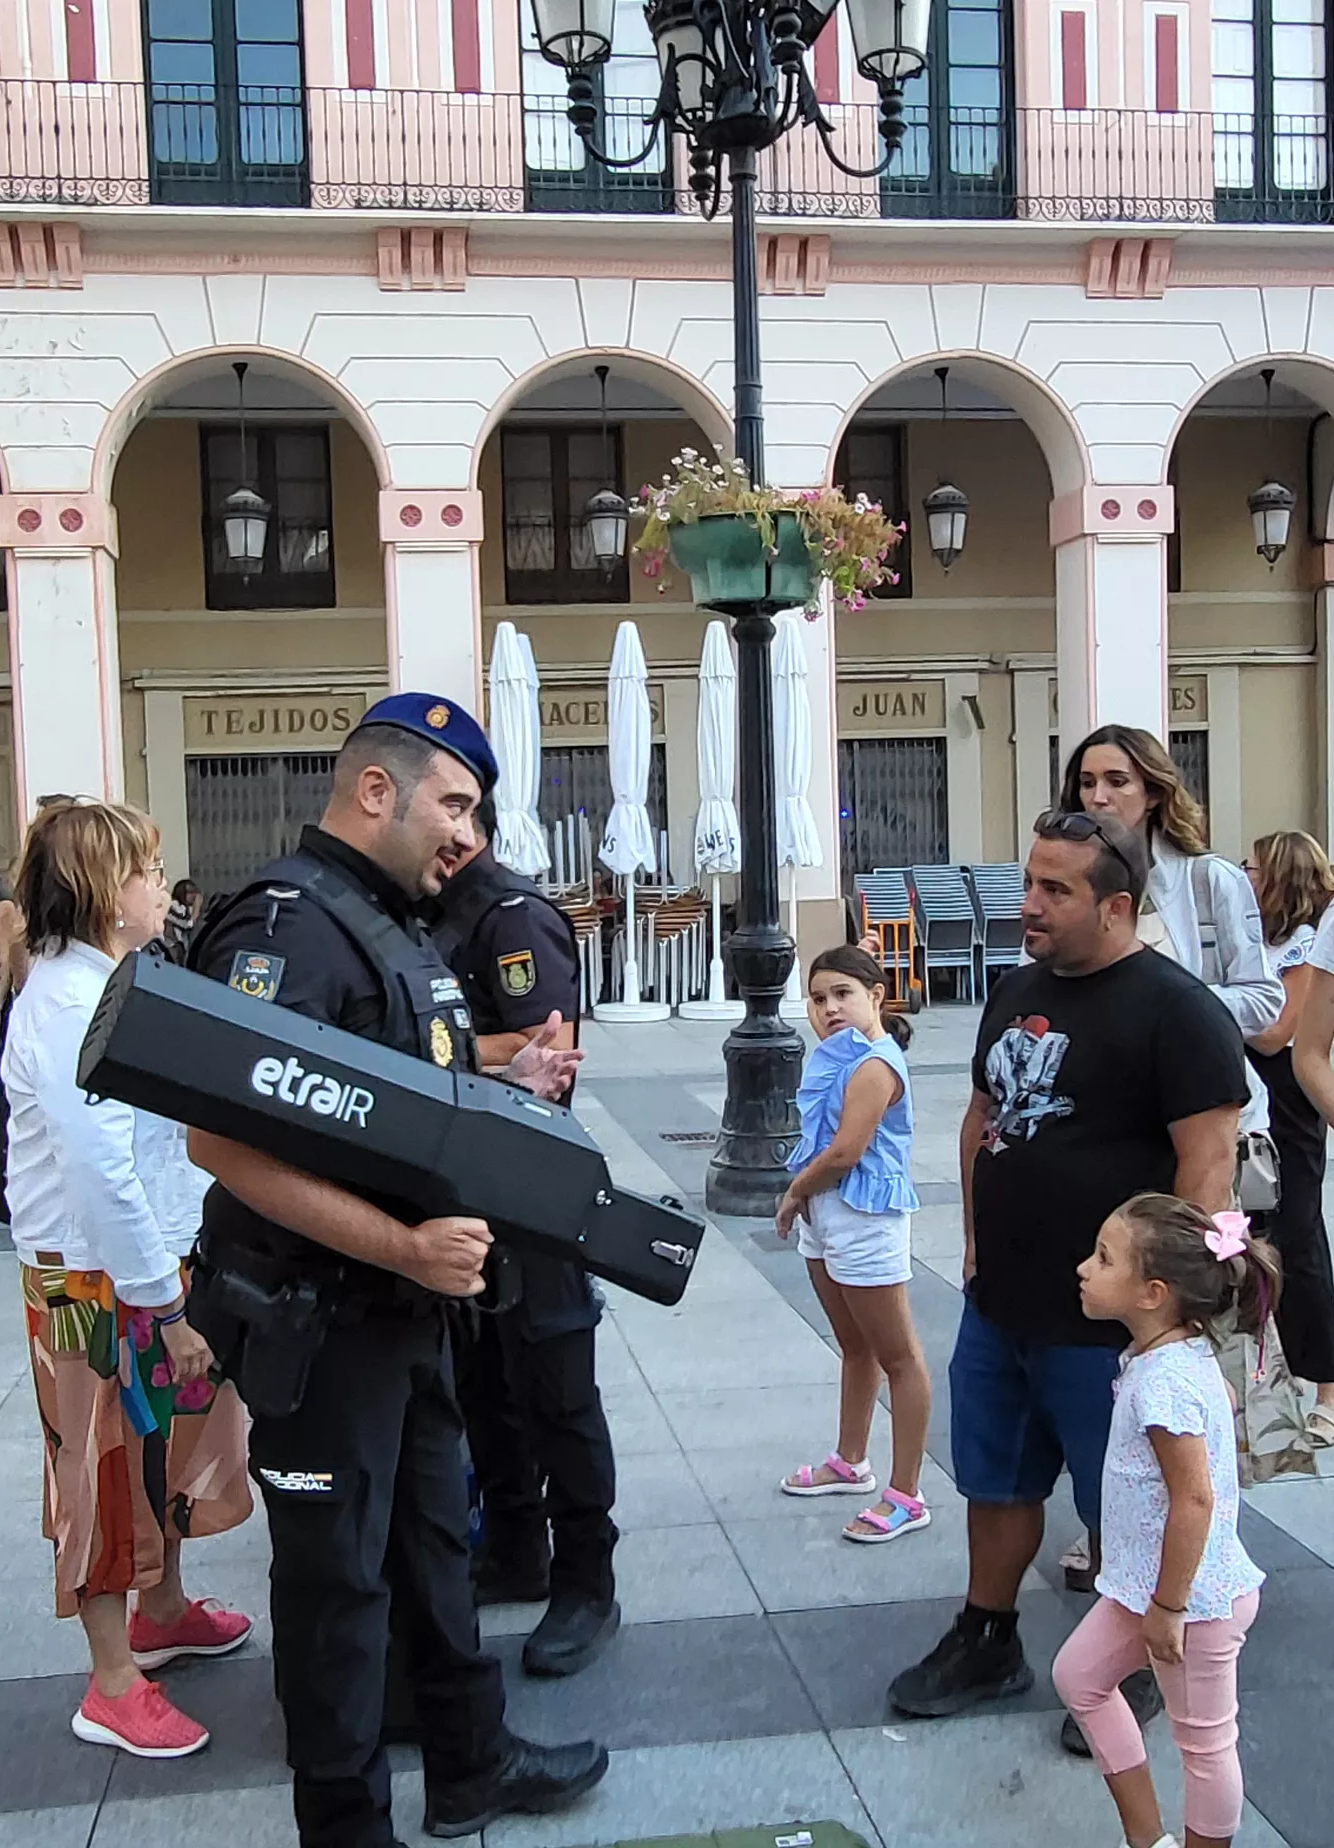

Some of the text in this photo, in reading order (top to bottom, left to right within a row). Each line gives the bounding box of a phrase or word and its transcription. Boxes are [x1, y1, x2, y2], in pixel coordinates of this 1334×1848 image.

[853, 692, 927, 717] JUAN
[1170, 687, 1196, 711] ES
[200, 707, 351, 736] TEJIDOS
